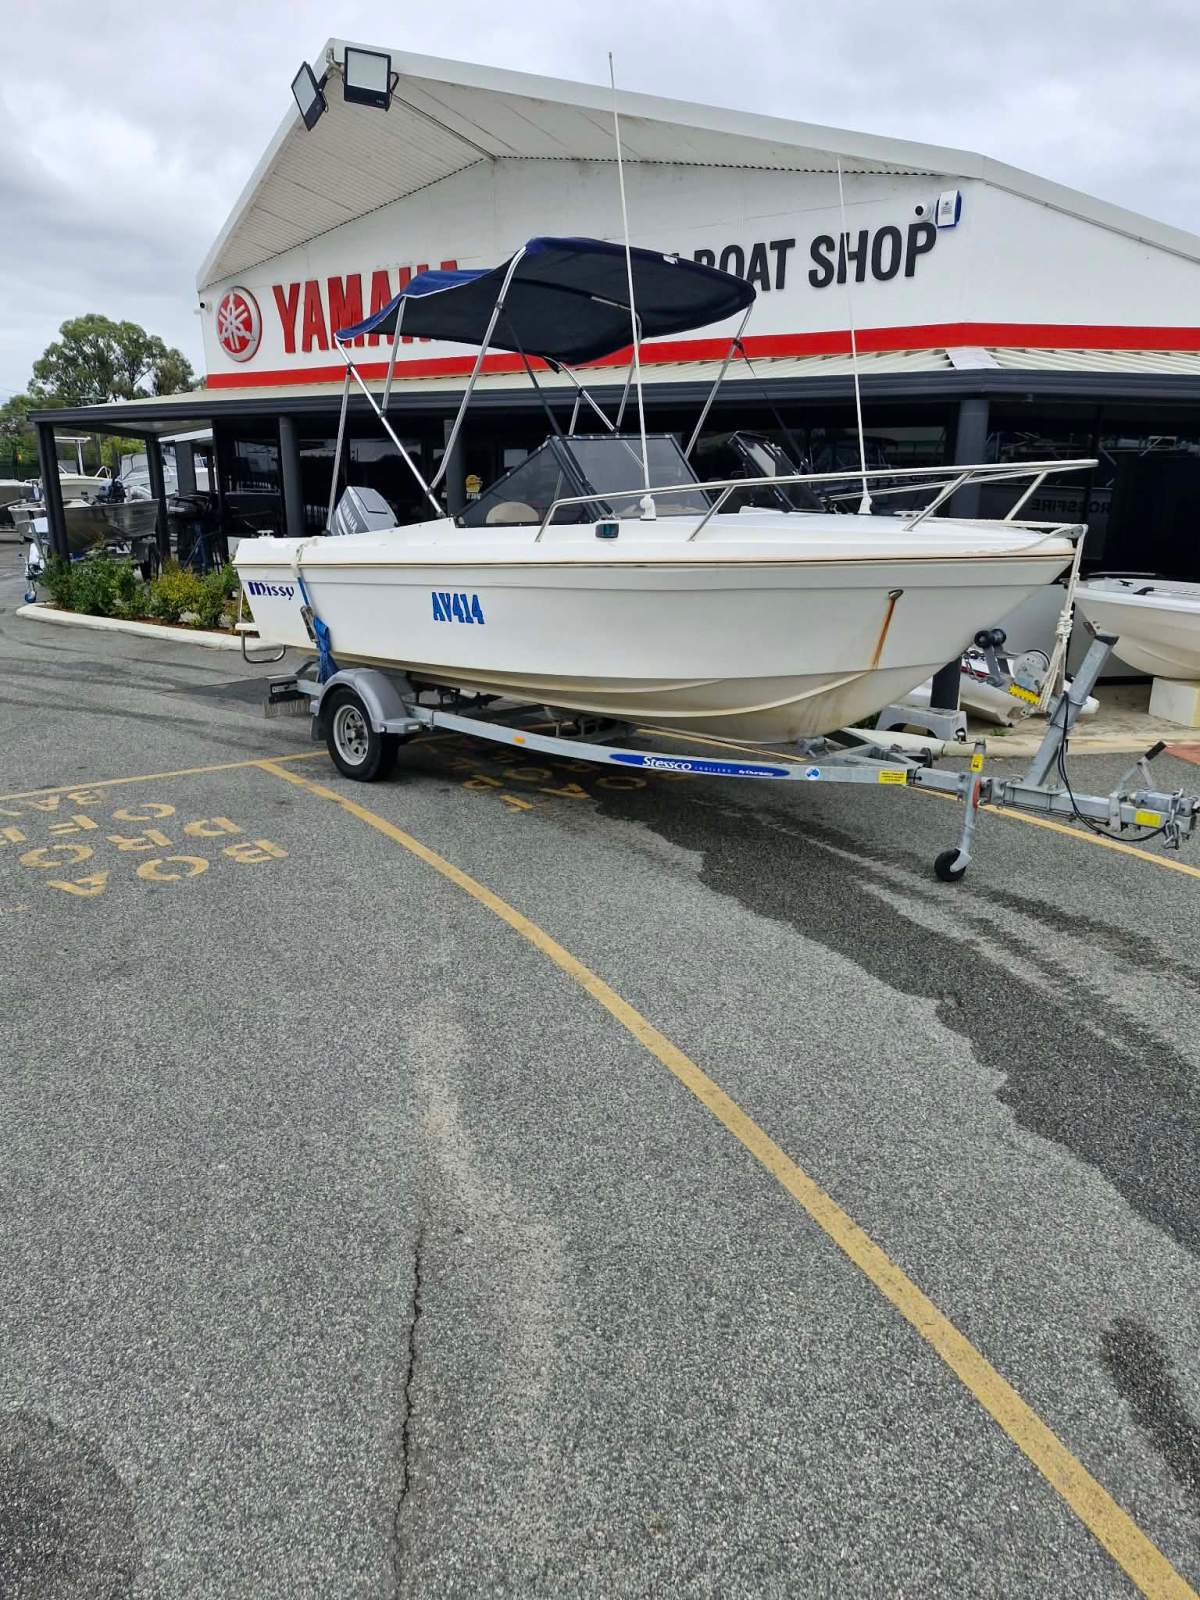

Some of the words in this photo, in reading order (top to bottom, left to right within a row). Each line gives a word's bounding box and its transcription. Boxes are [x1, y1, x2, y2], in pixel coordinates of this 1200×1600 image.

[272, 260, 457, 353] YAMA
[808, 222, 937, 288] SHOP
[248, 582, 295, 600] Missy
[432, 592, 485, 624] AV414
[643, 755, 692, 771] Stessco
